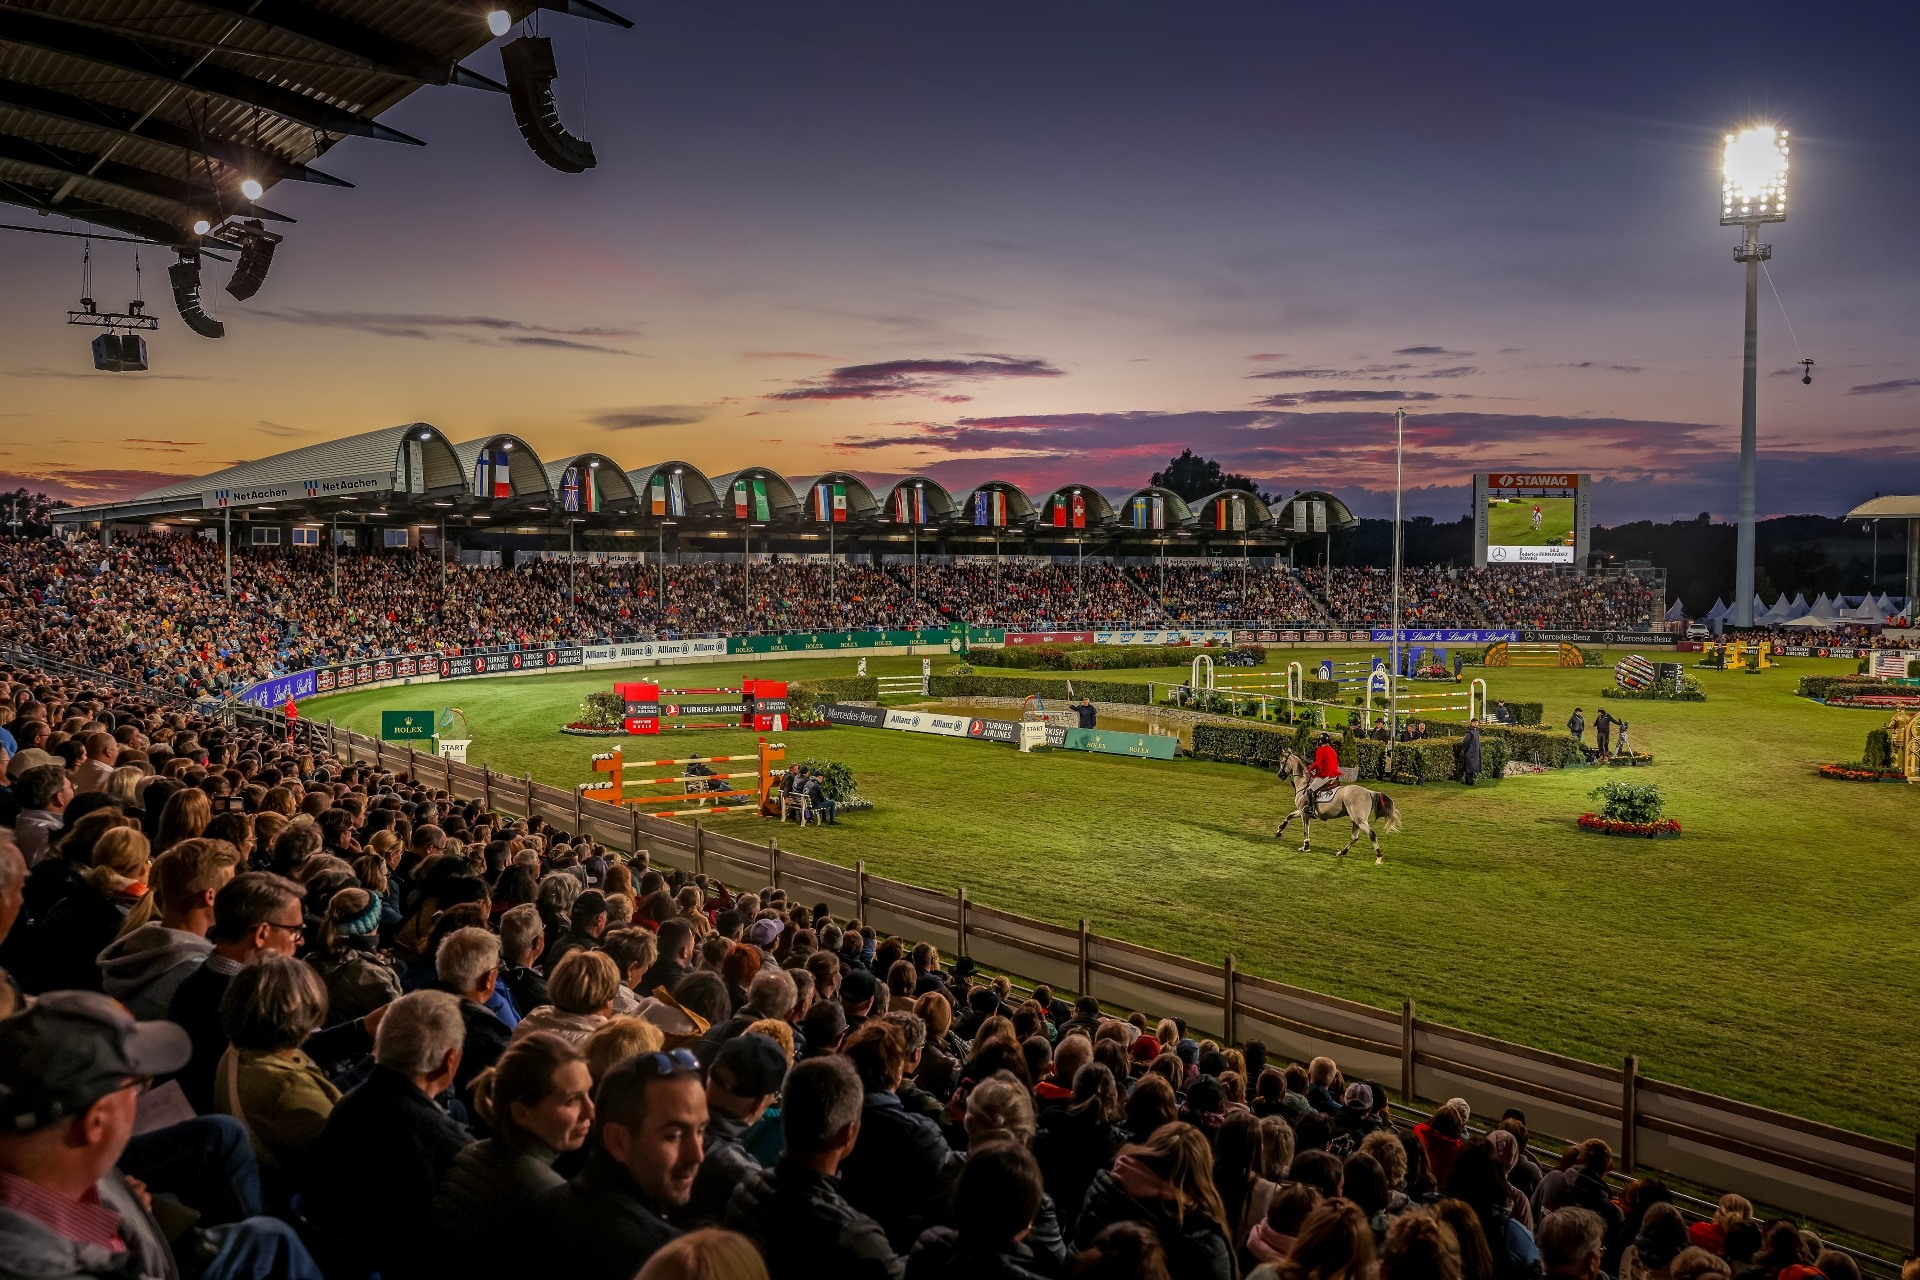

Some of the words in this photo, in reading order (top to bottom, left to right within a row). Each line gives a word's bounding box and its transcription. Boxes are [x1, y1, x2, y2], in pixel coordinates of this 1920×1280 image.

[322, 478, 378, 492] NetAachen
[1516, 475, 1568, 486] STAWAG
[233, 488, 288, 501] NetAachen
[1410, 631, 1434, 641] Lindt
[1446, 631, 1470, 641] Lindt
[1482, 631, 1508, 642] Lindt
[1537, 633, 1591, 642] Mercedes-Benz
[1616, 634, 1672, 643] Mercedes-Benz
[621, 648, 644, 656] Allianz
[658, 646, 680, 654] Allianz
[694, 644, 715, 652] Allianz
[586, 650, 607, 659] Allianz
[450, 658, 472, 667] TURKISH
[486, 656, 509, 664] TURKISH
[450, 666, 472, 675] AIRLINES
[486, 664, 509, 672] AIRLINES
[682, 706, 714, 714] TURKISH
[714, 704, 747, 712] AIRLINES
[826, 708, 878, 723] Mercedes-Benz
[890, 714, 911, 725] Allianz
[931, 719, 953, 730] Allianz
[985, 722, 1013, 730] TURKISH
[984, 729, 1012, 739] AIRLINES
